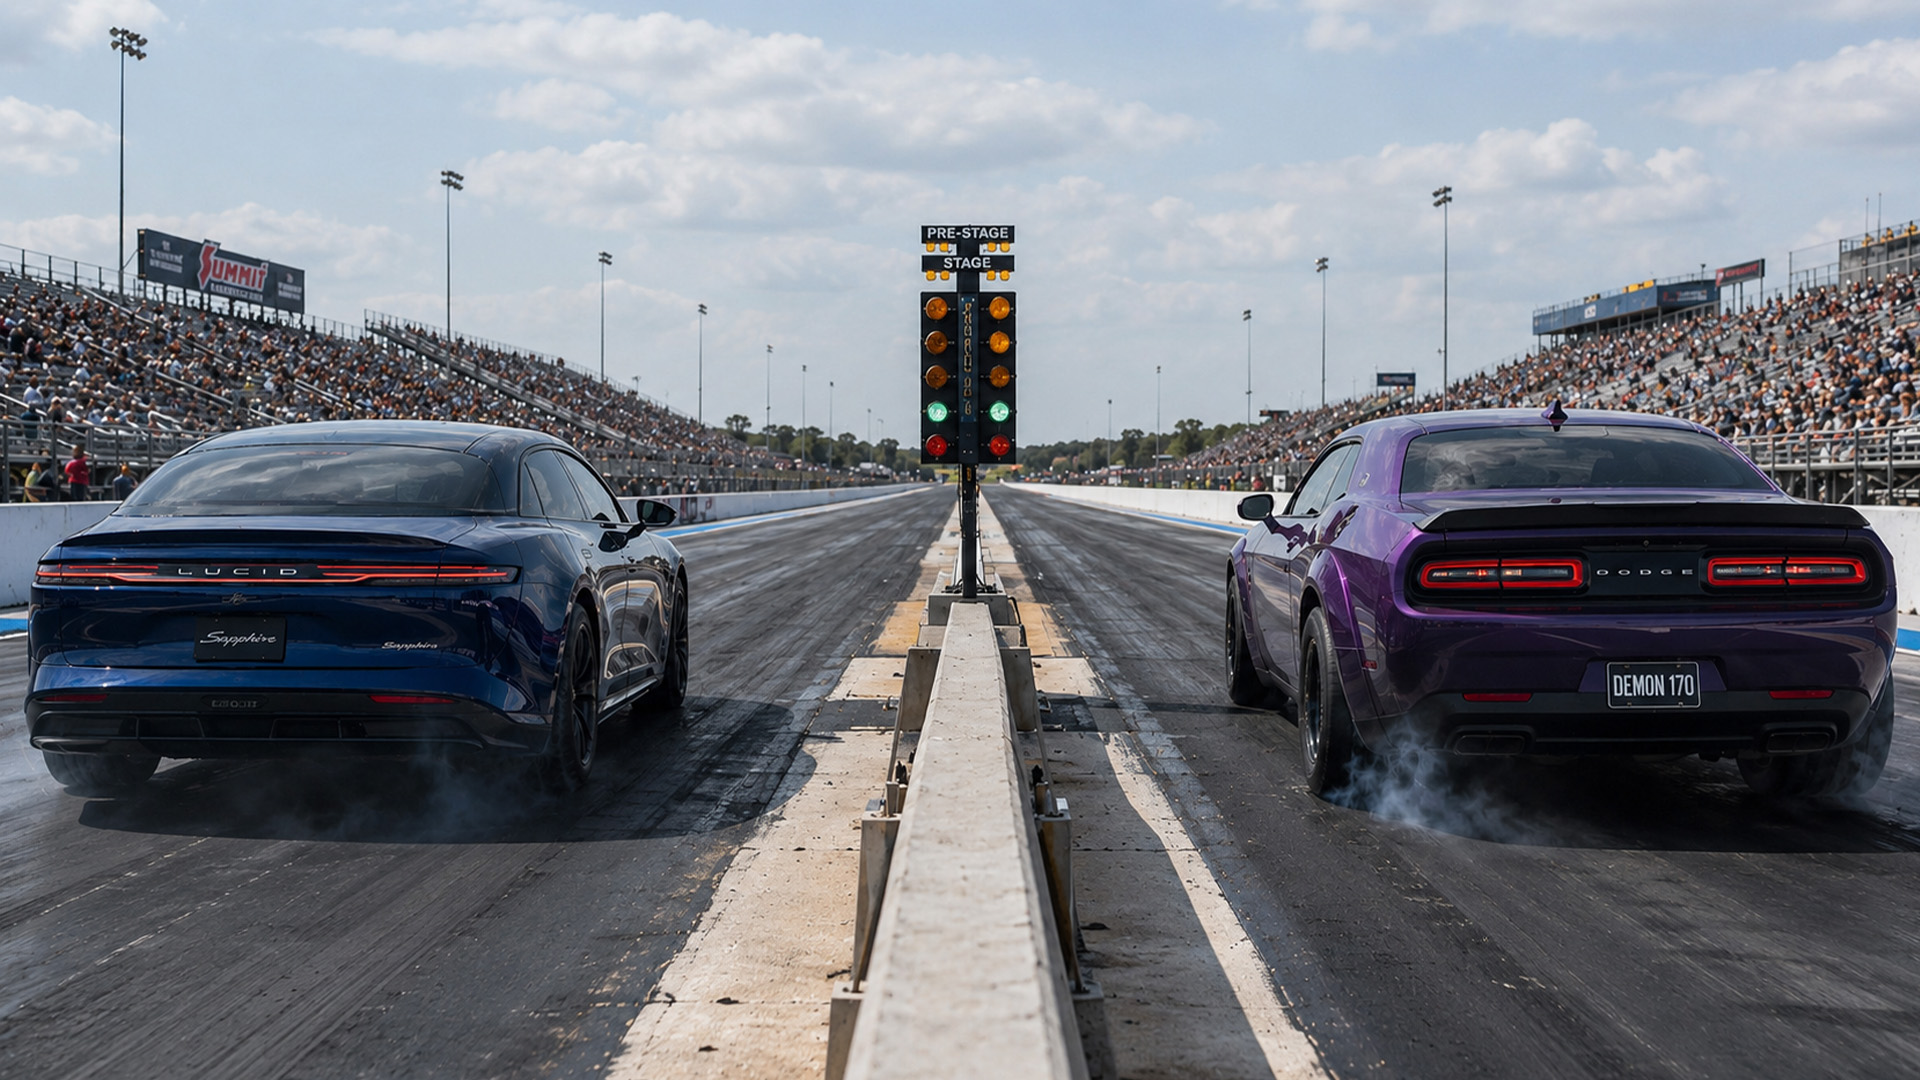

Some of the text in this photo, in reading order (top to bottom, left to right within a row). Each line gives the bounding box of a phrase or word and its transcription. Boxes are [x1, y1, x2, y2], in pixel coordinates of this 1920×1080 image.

[927, 227, 1009, 239] PRE-STAGE
[198, 242, 268, 291] SUMMIT
[943, 257, 992, 269] STAGE
[178, 568, 298, 576] LUCID
[1596, 568, 1693, 576] DODGE
[200, 631, 277, 647] Sapphire
[1613, 674, 1694, 697] DEMON 170
